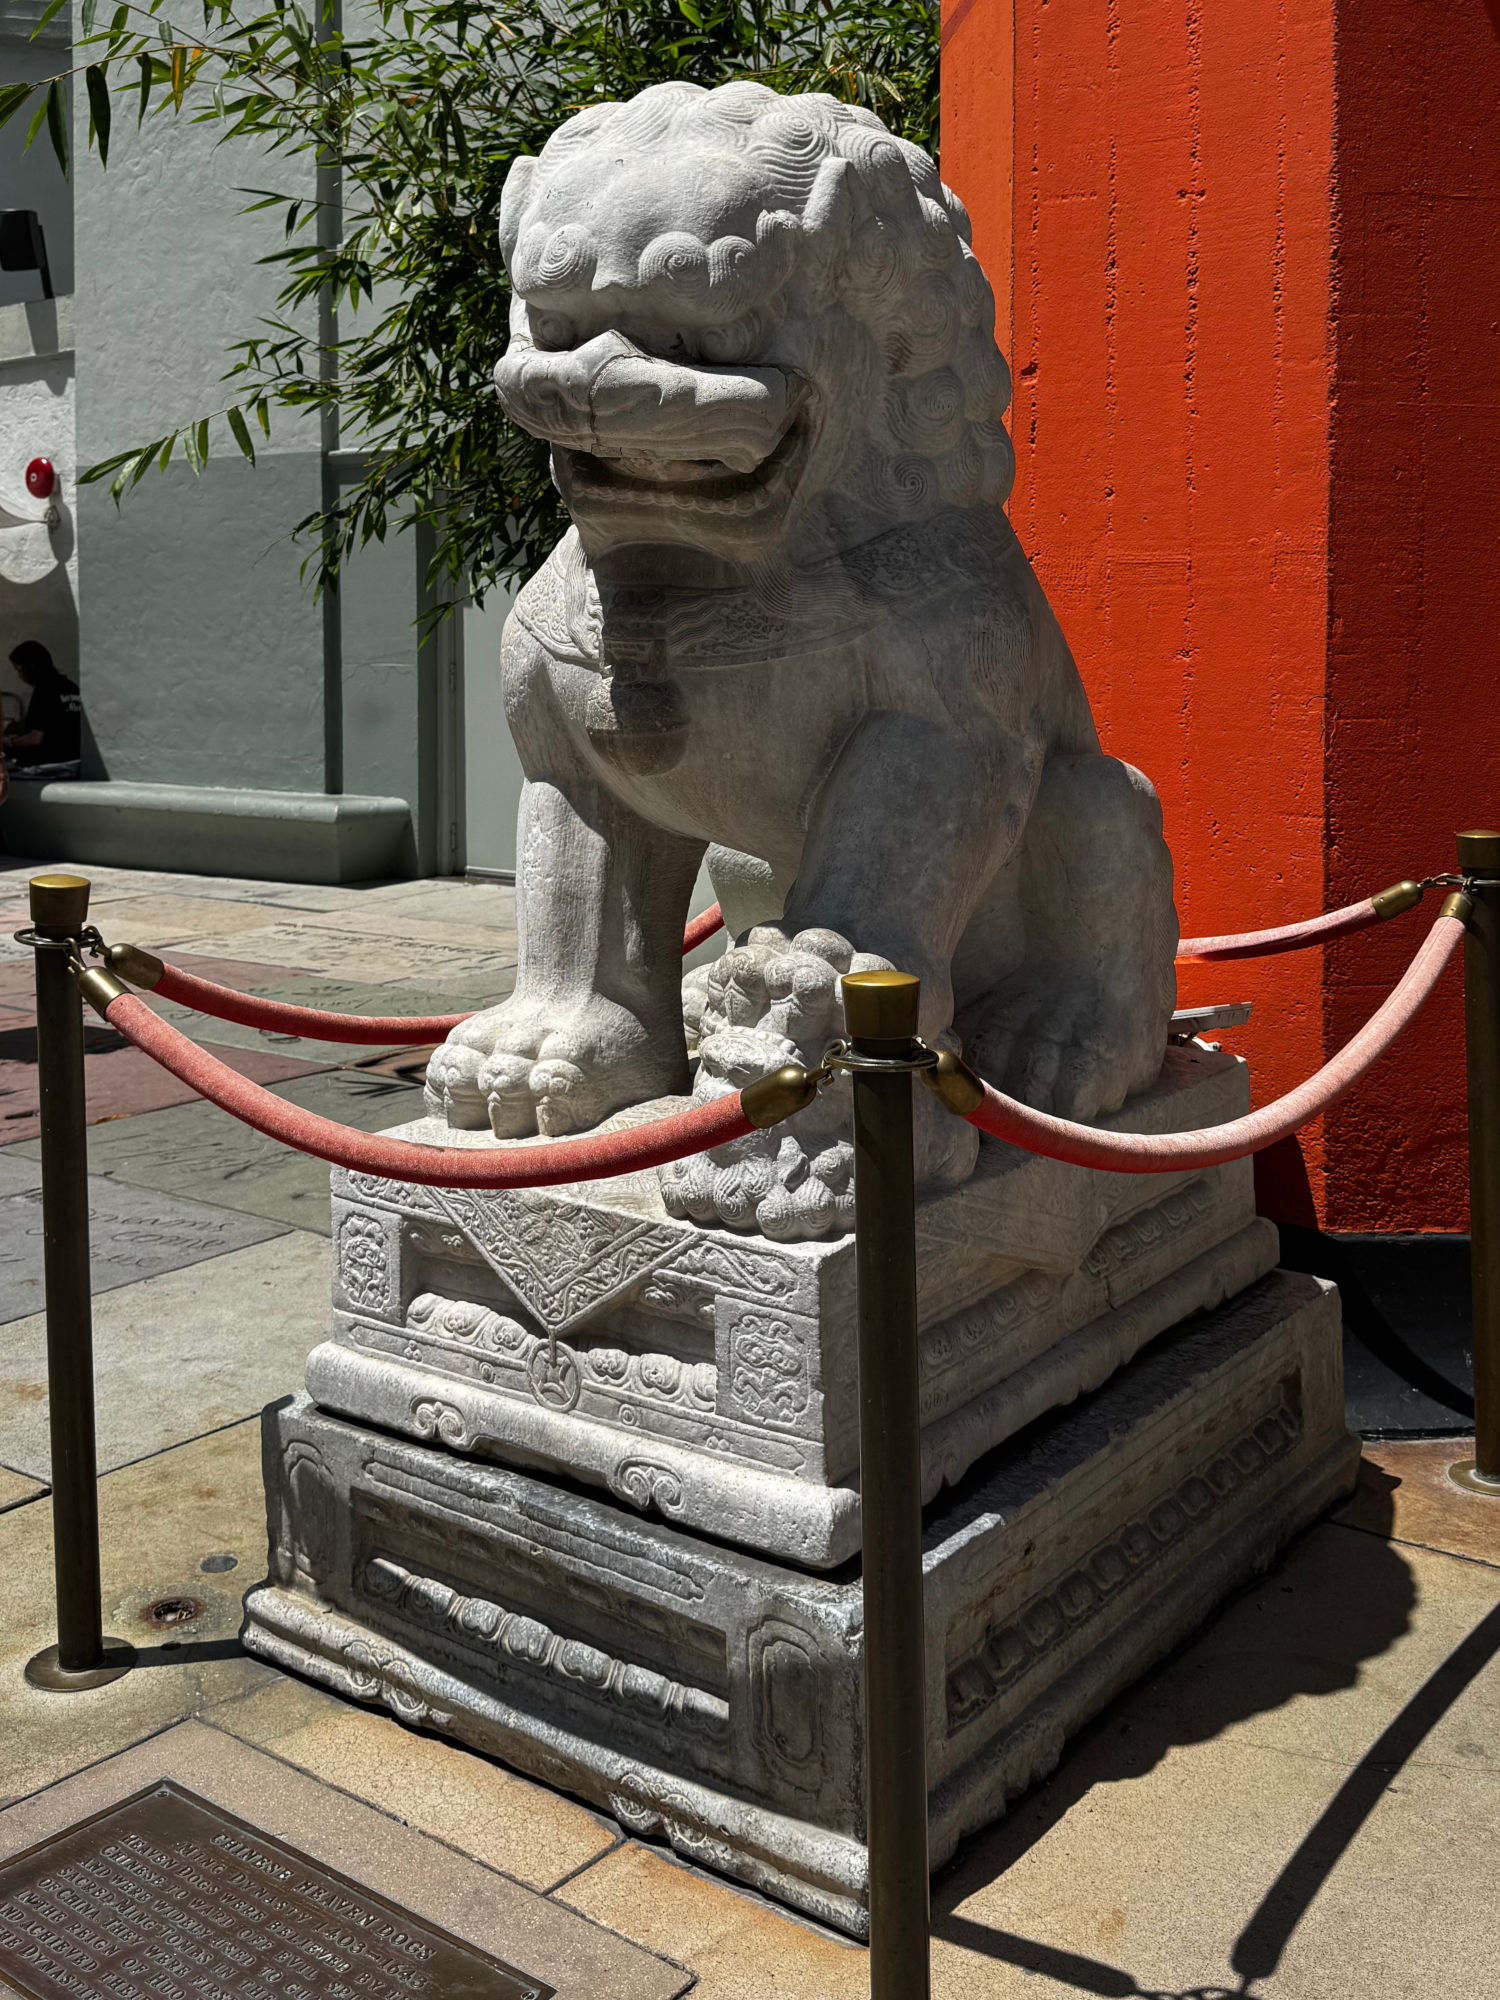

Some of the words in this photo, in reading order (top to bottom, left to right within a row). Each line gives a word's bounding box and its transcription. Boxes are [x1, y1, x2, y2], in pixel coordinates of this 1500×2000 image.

[37, 1878, 62, 1892] OF
[101, 1917, 145, 1946] THEY
[144, 1944, 192, 1978] WERE
[57, 1866, 117, 1904] SACRED
[115, 1899, 157, 1930] MING
[155, 1924, 214, 1965] TOMBS
[211, 1962, 238, 1979] IN
[77, 1859, 112, 1877] AND
[110, 1874, 153, 1903] WERE
[152, 1899, 214, 1938] WIDELY
[211, 1939, 256, 1966] USED
[259, 1966, 283, 1982] TO
[101, 1845, 166, 1886] CHINESE
[166, 1885, 190, 1899] TO
[188, 1897, 236, 1927] WARD
[237, 1928, 274, 1950] OFF
[273, 1950, 319, 1980] EVIL
[119, 1833, 178, 1869] HEAVEN
[176, 1865, 220, 1895] DOGS
[219, 1892, 267, 1922] WERE
[266, 1921, 351, 1972] BELIEVED
[354, 1972, 385, 1990] BY
[176, 1842, 226, 1874] MING
[228, 1872, 312, 1923] DYNASTY
[211, 1833, 294, 1881] CHINESE
[291, 1881, 378, 1928] HEAVEN
[376, 1924, 436, 1960] DOGS
[0, 1925, 23, 1949] HE
[18, 1920, 99, 1972] ACHIEVED
[65, 1921, 120, 1957] REIGN
[121, 1958, 149, 1975] OF
[145, 1972, 186, 2000] HUO
